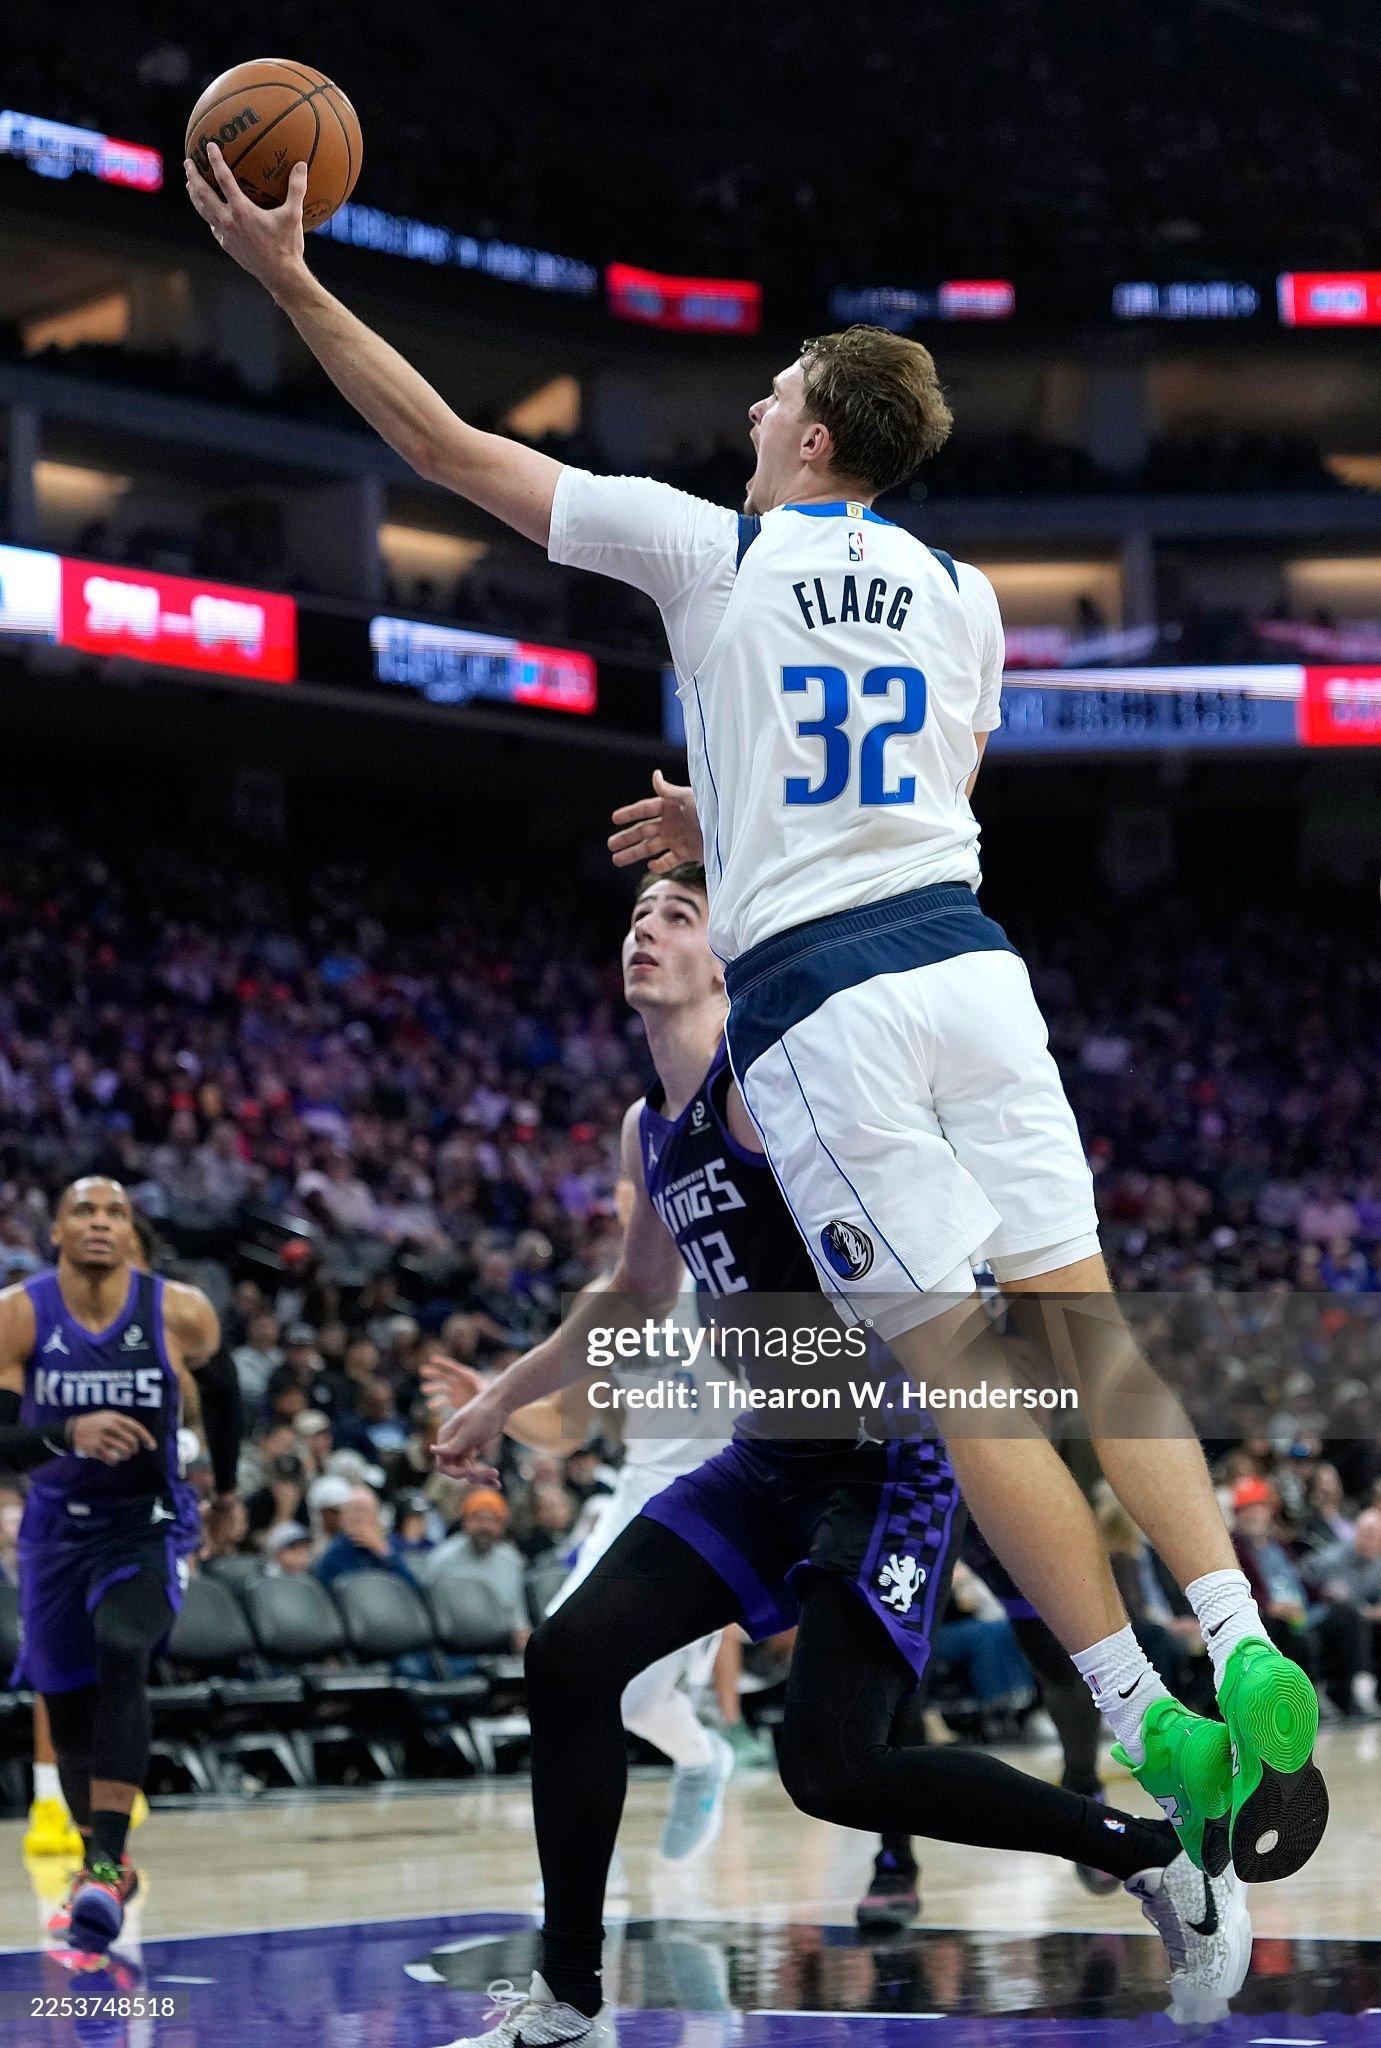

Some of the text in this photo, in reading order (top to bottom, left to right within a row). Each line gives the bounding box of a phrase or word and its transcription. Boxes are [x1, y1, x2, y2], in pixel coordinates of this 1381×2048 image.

[792, 575, 914, 632] FLAGG
[781, 665, 929, 806] 32
[680, 1230, 749, 1300] 42
